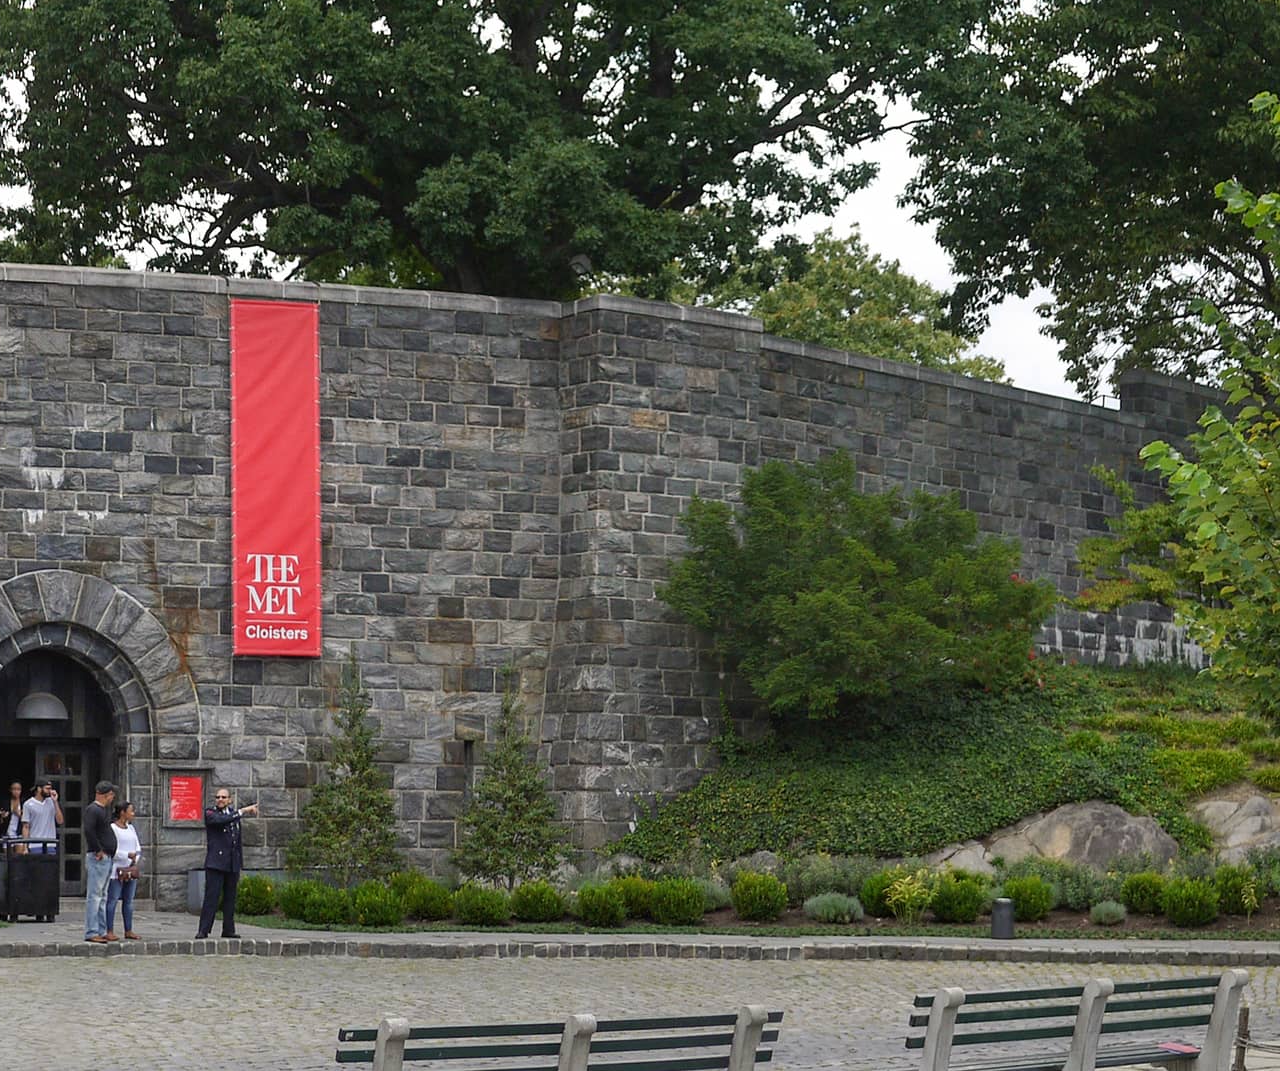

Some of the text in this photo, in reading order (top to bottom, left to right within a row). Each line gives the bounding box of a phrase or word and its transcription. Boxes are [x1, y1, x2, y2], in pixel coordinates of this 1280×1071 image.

[246, 553, 300, 584] THE
[245, 584, 302, 615] MET
[245, 625, 308, 640] Cloisters
